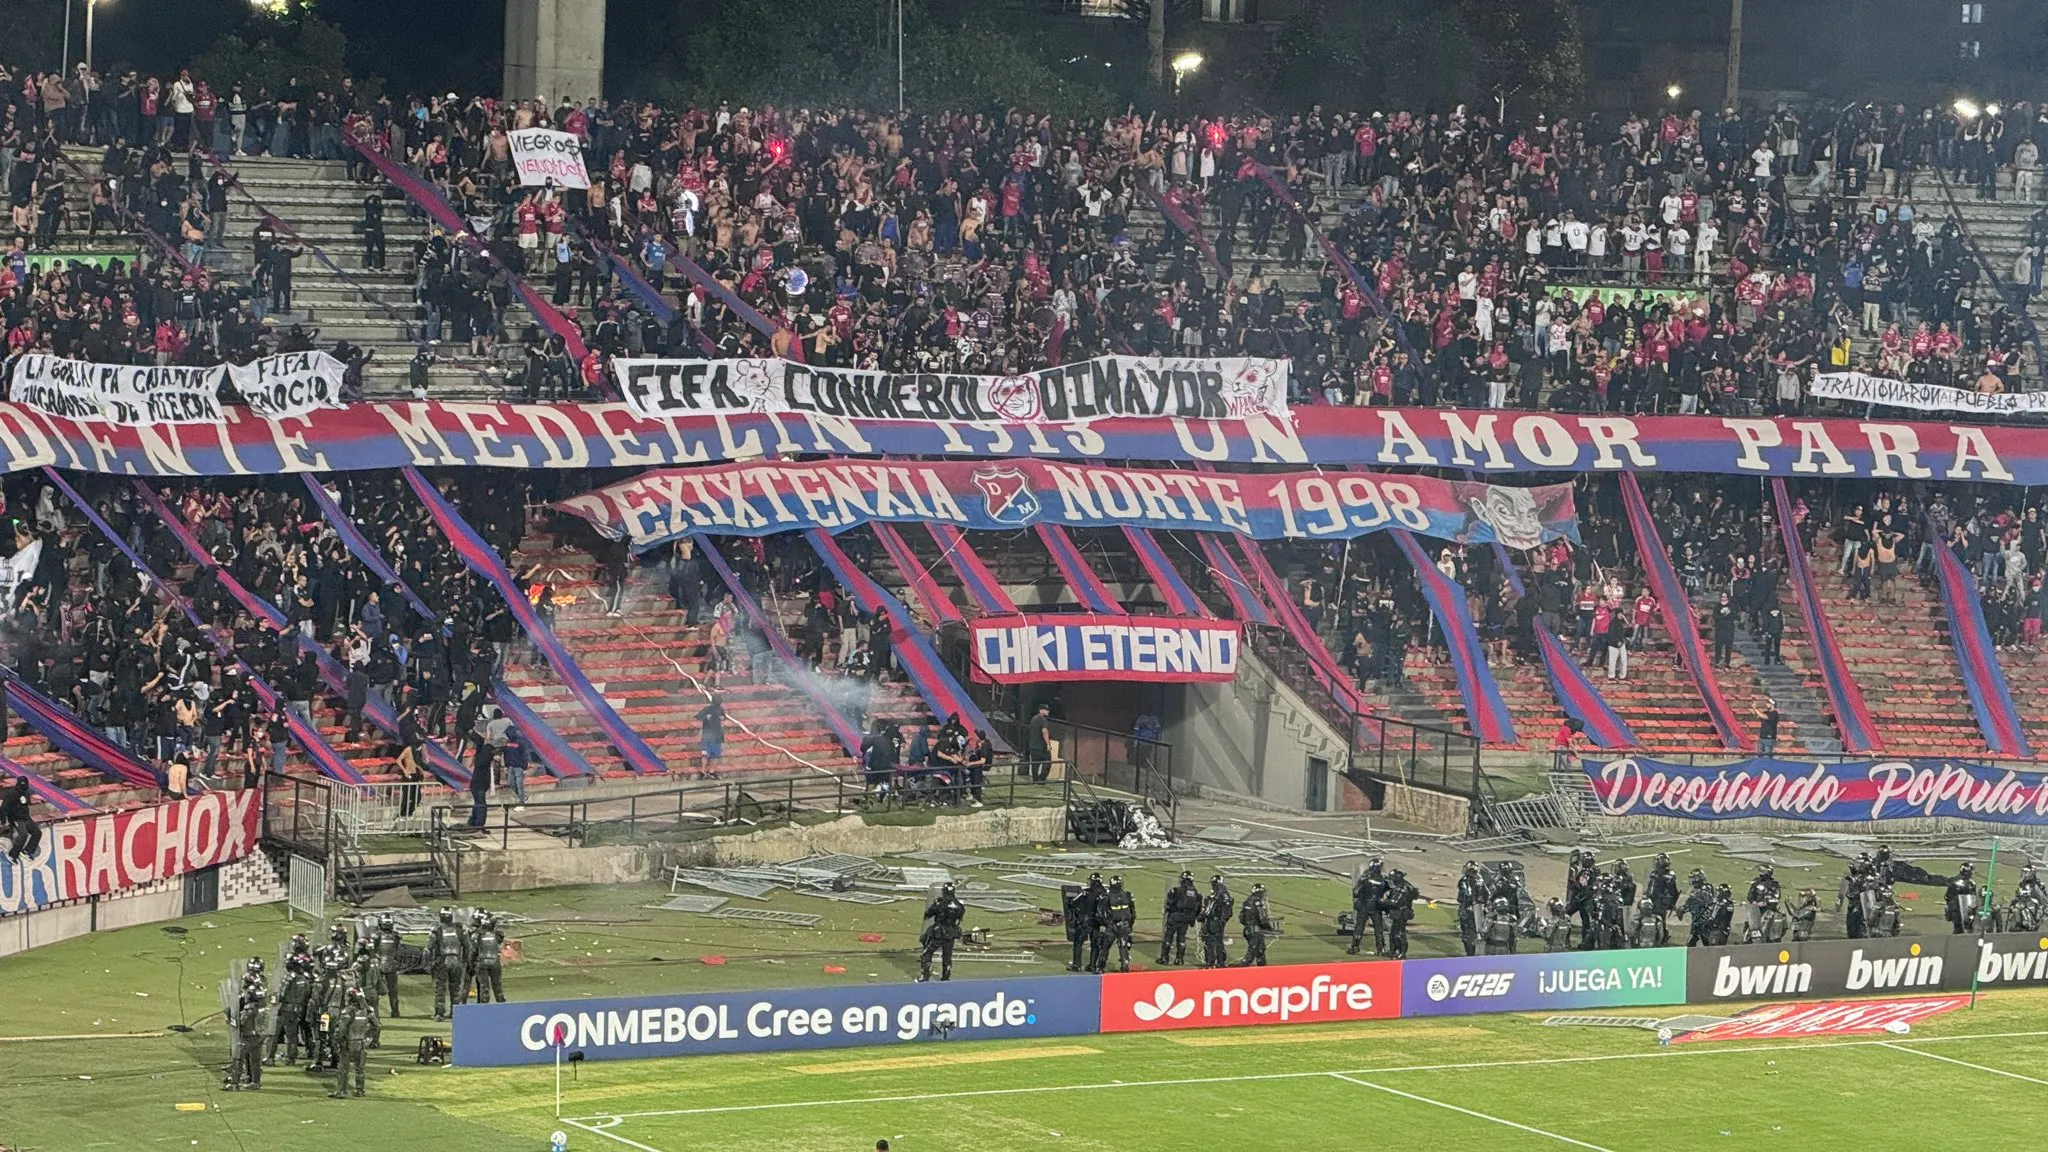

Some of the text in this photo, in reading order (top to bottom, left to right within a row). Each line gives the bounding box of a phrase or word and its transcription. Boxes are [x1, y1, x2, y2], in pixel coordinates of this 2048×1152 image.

[628, 363, 750, 411] FIFA
[784, 362, 1002, 421] CONMEBOL
[1169, 412, 1309, 463] UN
[1376, 410, 1657, 469] AMOR
[1722, 418, 2015, 482] PARA
[1045, 465, 1253, 535] NORTE
[1267, 477, 1432, 538] 1998
[1080, 625, 1238, 673] ETERNO
[1539, 966, 1663, 994] ¡JUEGA YA!
[1713, 950, 1813, 996] bwin
[1845, 943, 1944, 989] bwin
[1977, 937, 2048, 982] bwi
[1203, 975, 1373, 1021] mapfre
[1450, 973, 1516, 998] FC26
[521, 1004, 739, 1051] CONMEBOL
[747, 1002, 833, 1038] Cree
[842, 1005, 888, 1033] en
